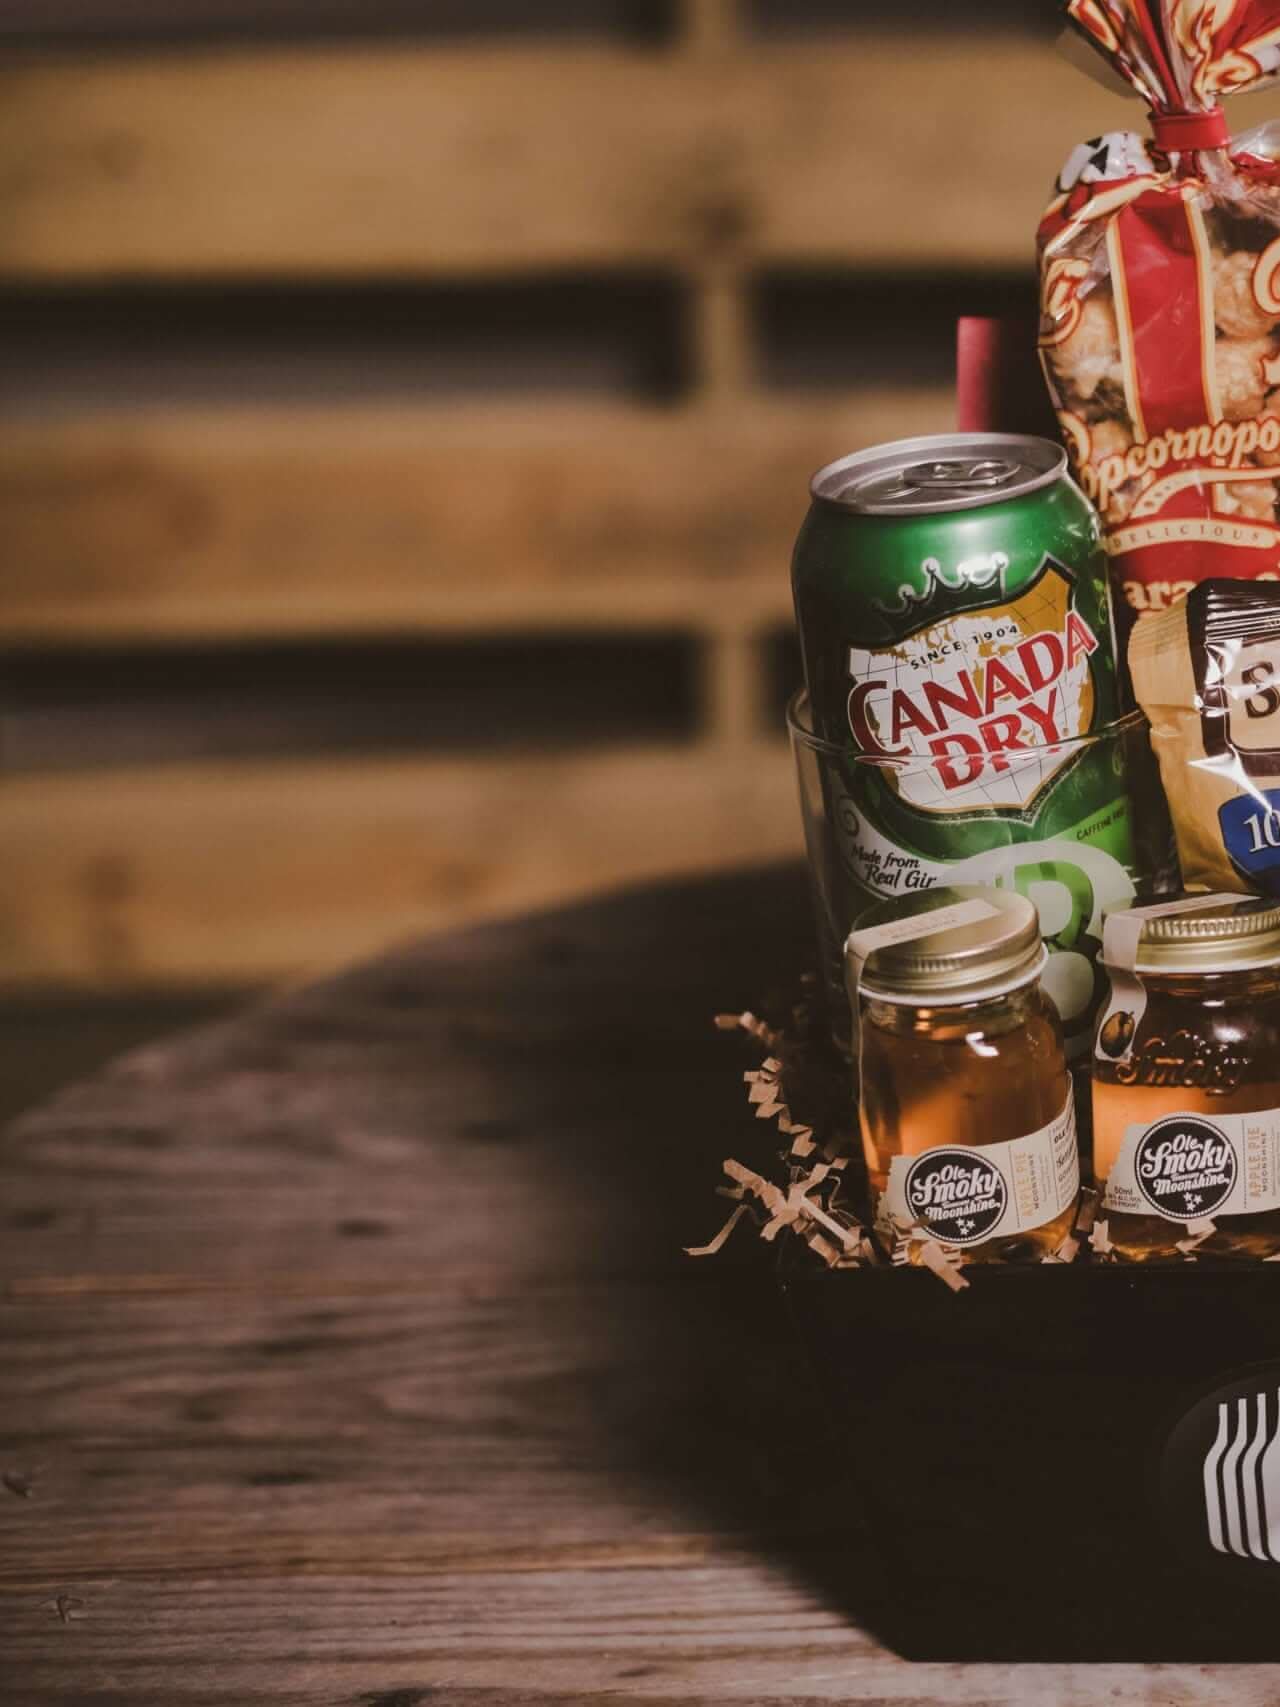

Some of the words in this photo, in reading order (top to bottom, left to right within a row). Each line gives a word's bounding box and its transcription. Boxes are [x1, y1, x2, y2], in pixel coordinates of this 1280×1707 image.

[1113, 524, 1260, 548] DELICIOUS
[909, 639, 962, 671] SINCE
[971, 623, 1020, 647] 1904
[847, 610, 1100, 760] CANADA
[927, 687, 1061, 791] DRY
[851, 844, 882, 865] Made
[883, 852, 921, 869] from
[863, 862, 901, 889] Real
[1172, 1134, 1203, 1153] Ole
[1141, 1139, 1232, 1179] Smoky
[911, 1168, 1000, 1206] Smoky
[940, 1165, 972, 1183] Ole
[1153, 1173, 1230, 1196] Moonshine
[925, 1199, 1001, 1220] Moonshine
